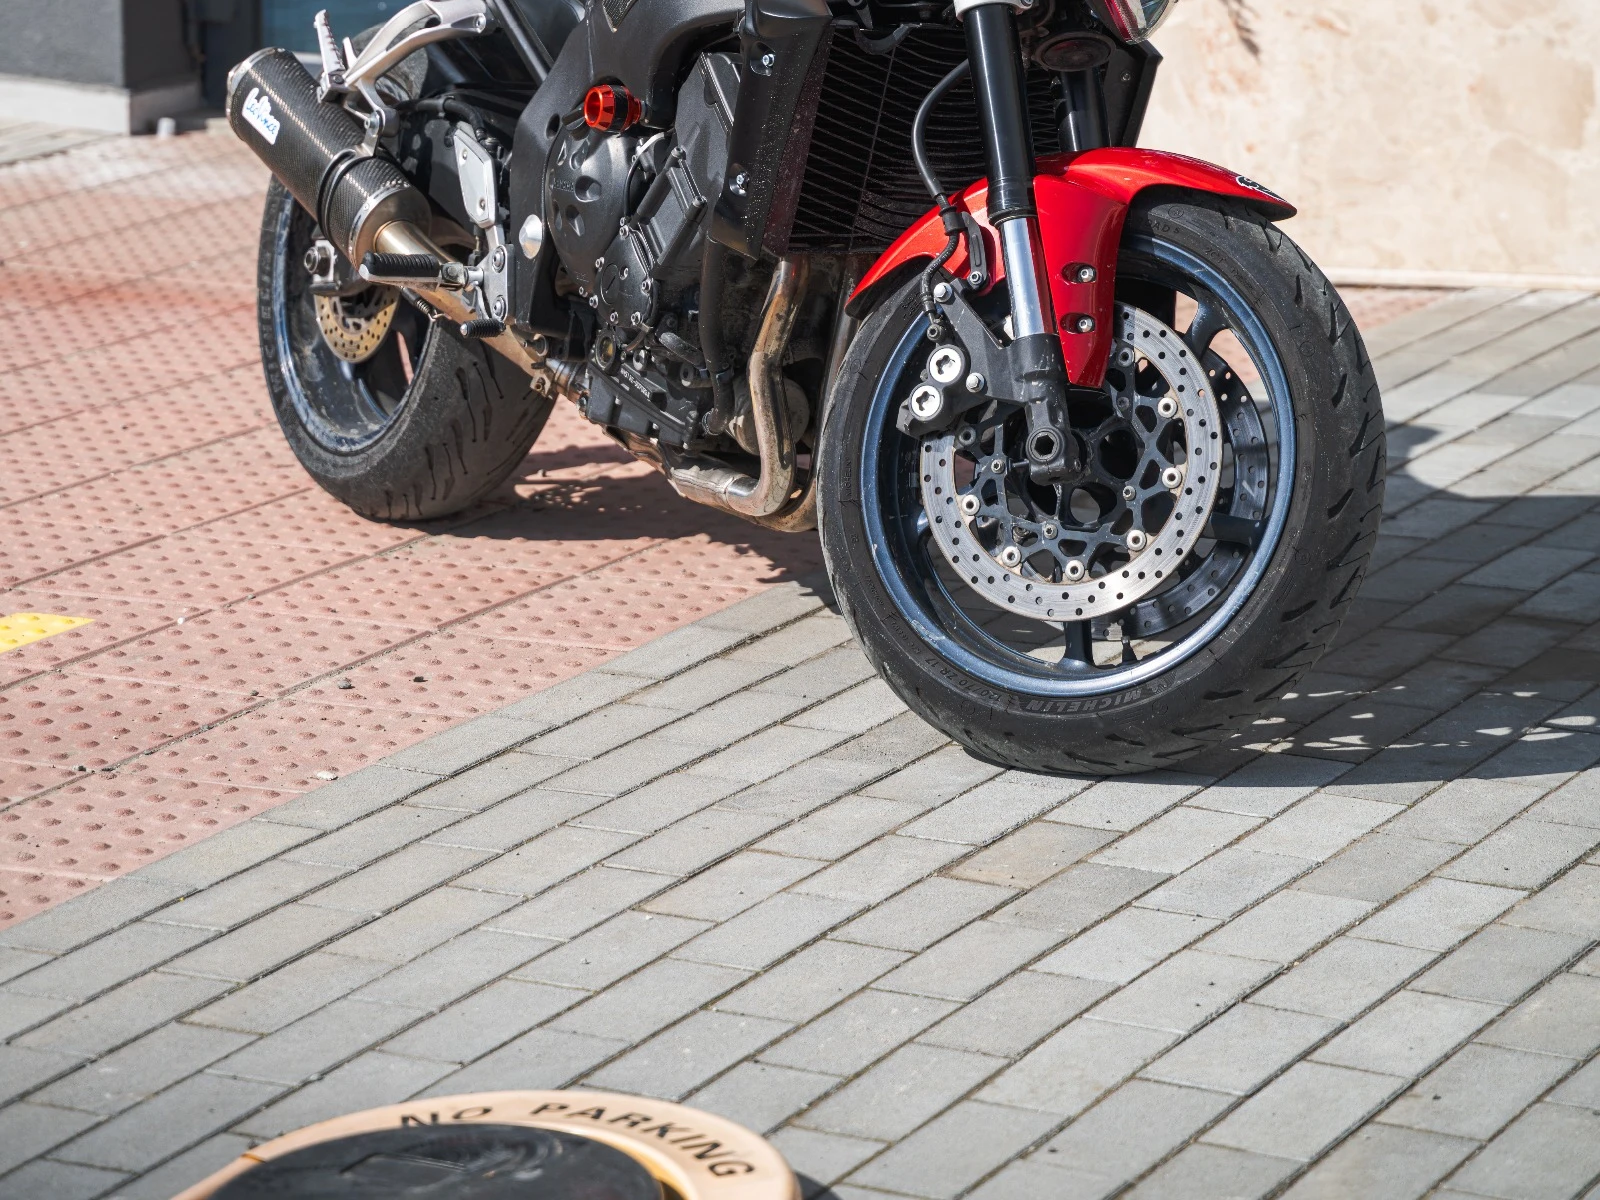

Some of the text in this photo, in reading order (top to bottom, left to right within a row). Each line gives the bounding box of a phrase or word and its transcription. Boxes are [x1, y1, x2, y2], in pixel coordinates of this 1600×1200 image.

[924, 657, 939, 668] 17
[938, 664, 957, 679] ZR
[957, 677, 1001, 702] 120/70
[1026, 689, 1141, 713] MICHELIN
[401, 1102, 754, 1177] NO PARKING
